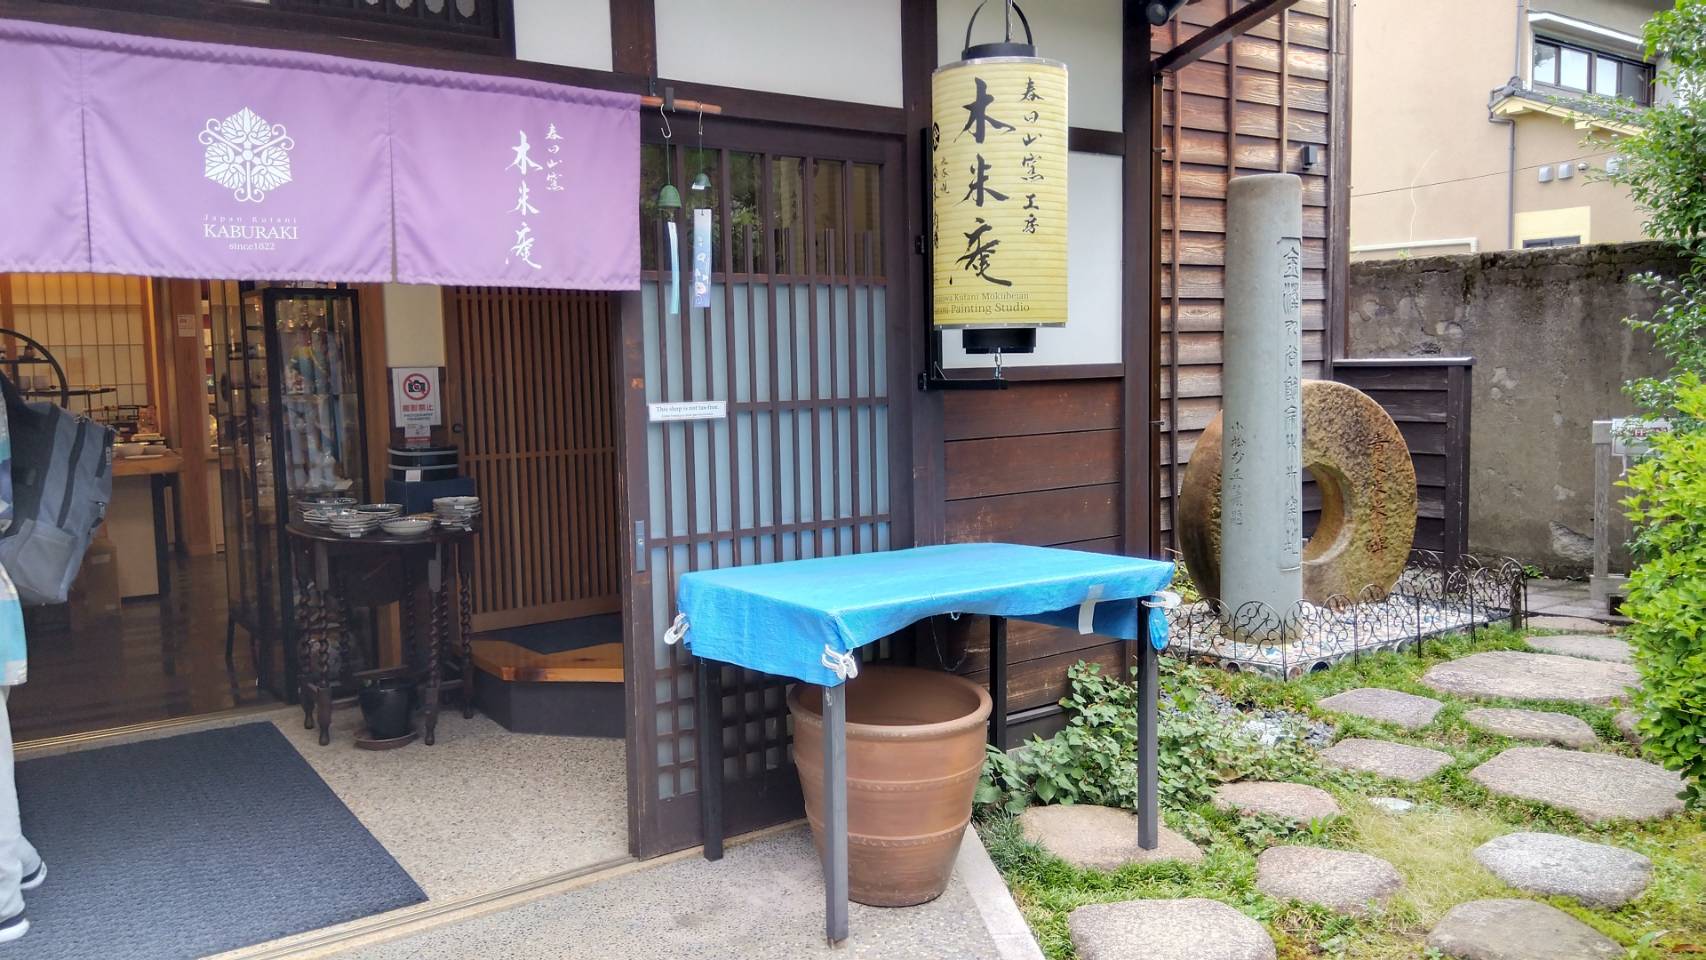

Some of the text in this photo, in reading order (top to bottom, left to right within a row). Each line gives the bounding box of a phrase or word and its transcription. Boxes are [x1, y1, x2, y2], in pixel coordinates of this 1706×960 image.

[203, 223, 299, 240] KABURAKI
[951, 304, 992, 315] Painting
[994, 302, 1030, 313] Studio
